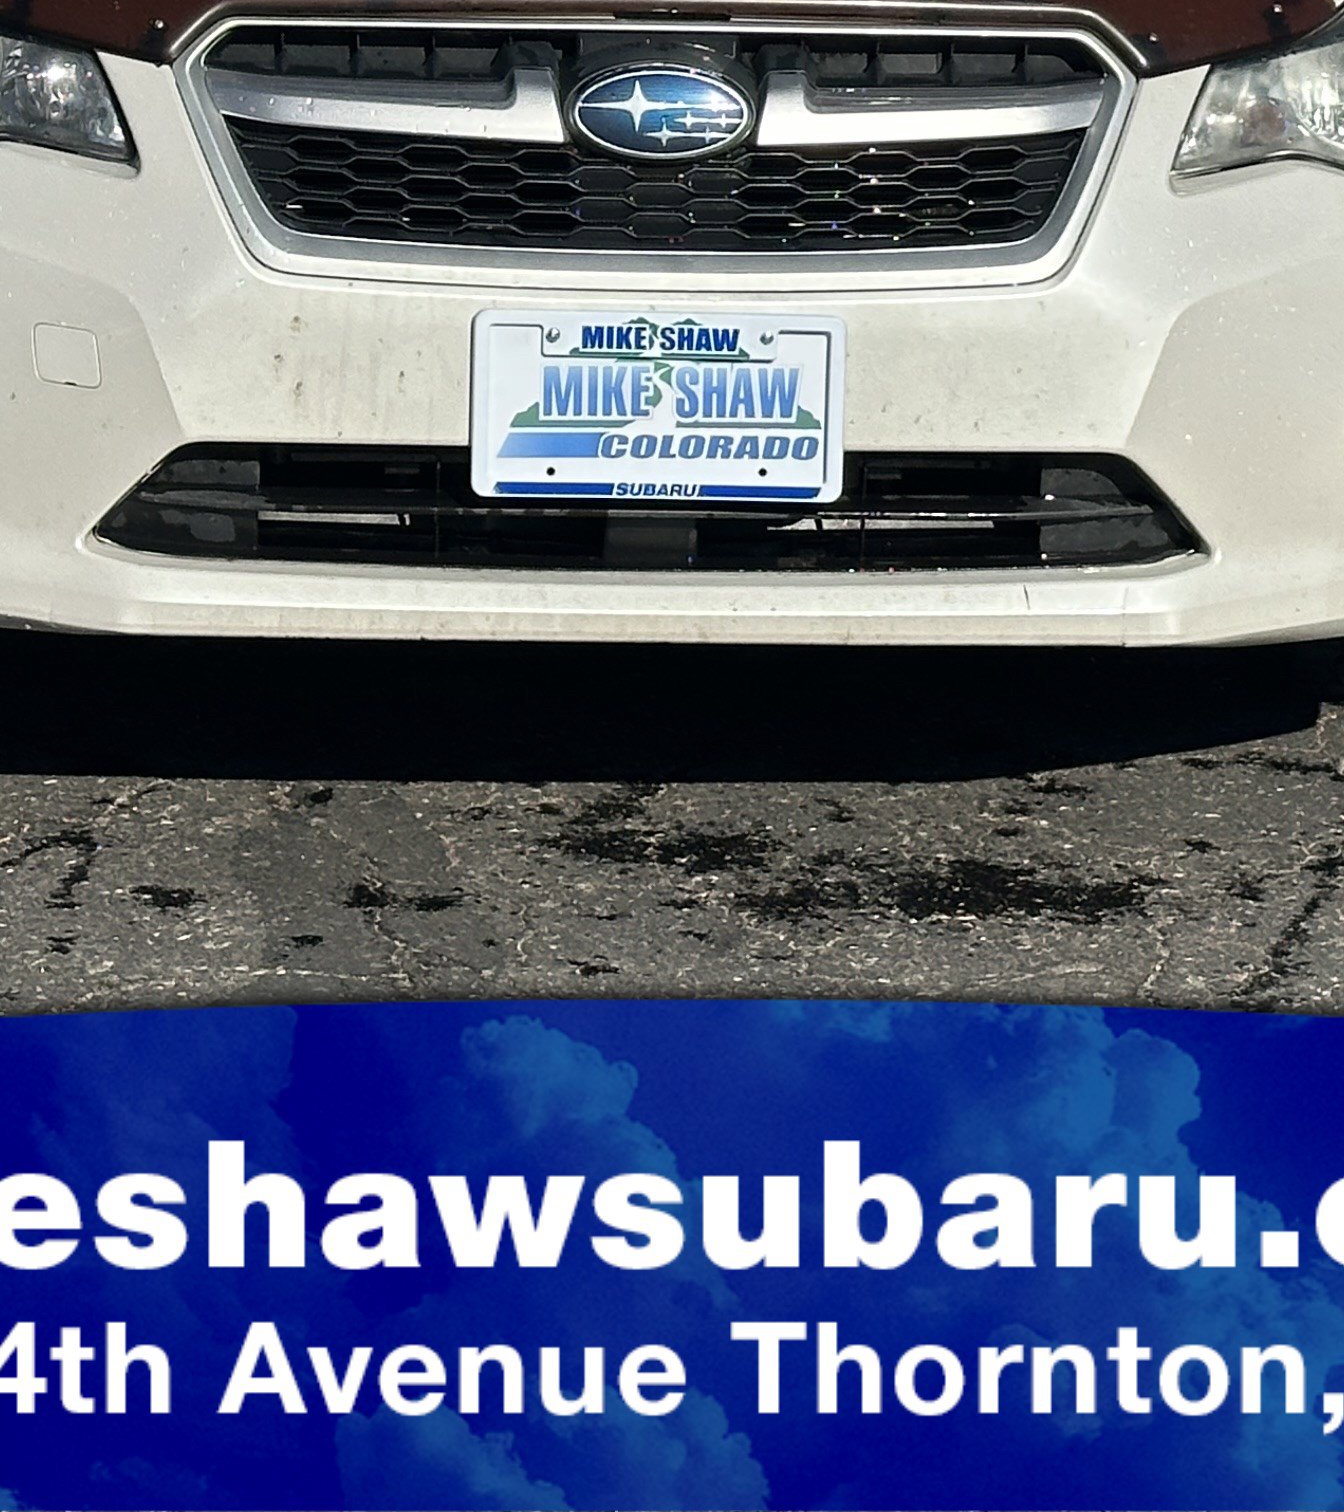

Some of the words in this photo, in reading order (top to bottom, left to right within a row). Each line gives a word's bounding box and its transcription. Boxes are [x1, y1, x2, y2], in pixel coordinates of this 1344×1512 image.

[581, 325, 647, 350] MIKE
[658, 327, 741, 353] SHAW
[543, 365, 653, 418] MIKE
[675, 366, 800, 420] SHAW
[600, 433, 820, 461] COLORADO
[615, 482, 698, 498] SUBARU
